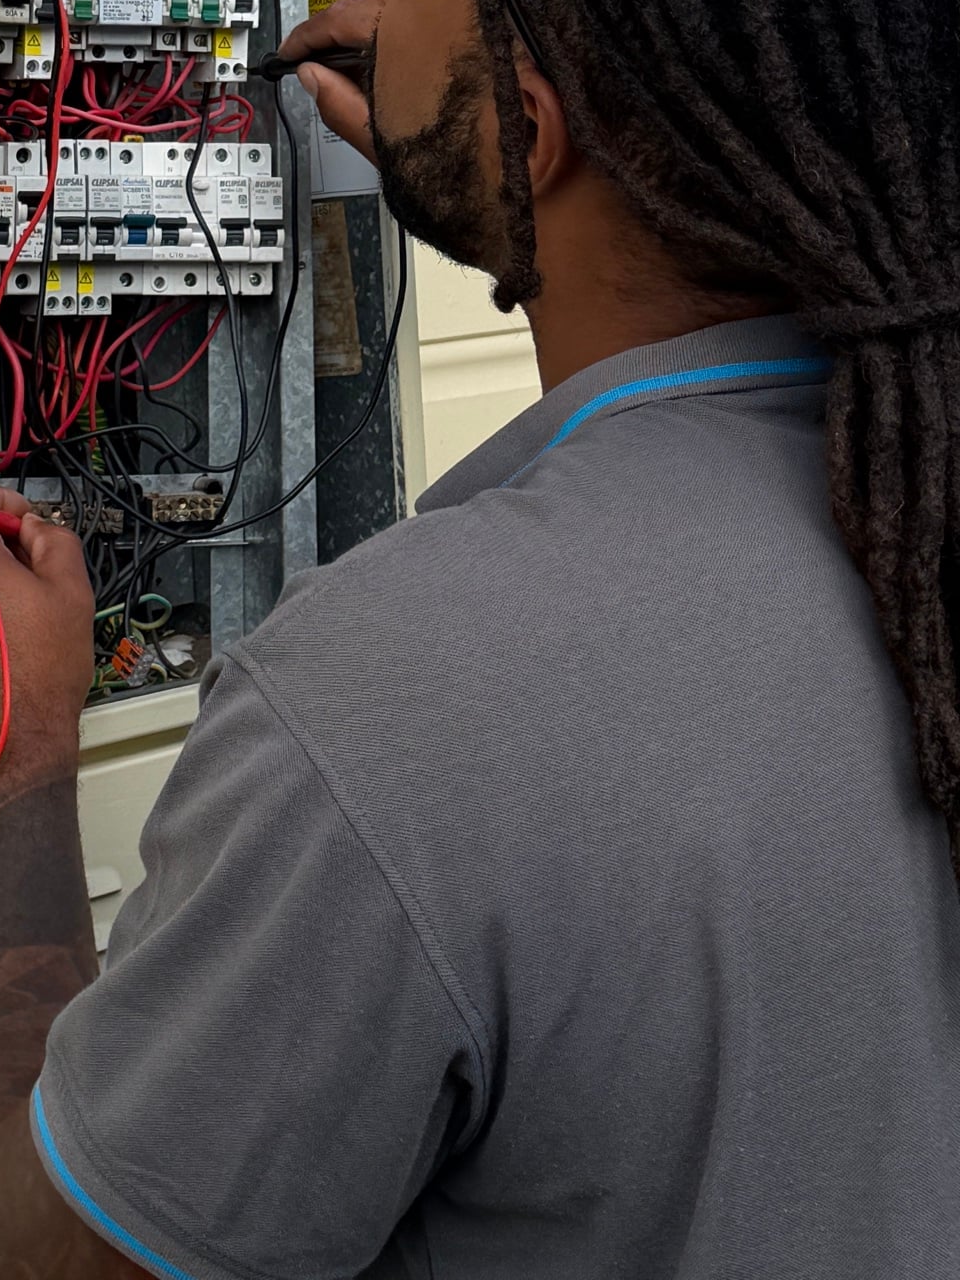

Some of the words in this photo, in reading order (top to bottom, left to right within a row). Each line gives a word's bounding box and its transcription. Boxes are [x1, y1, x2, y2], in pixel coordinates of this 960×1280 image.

[56, 178, 83, 187] CLIPSAL
[92, 178, 119, 187] CLIPSAL
[155, 179, 183, 188] CLIPSAL
